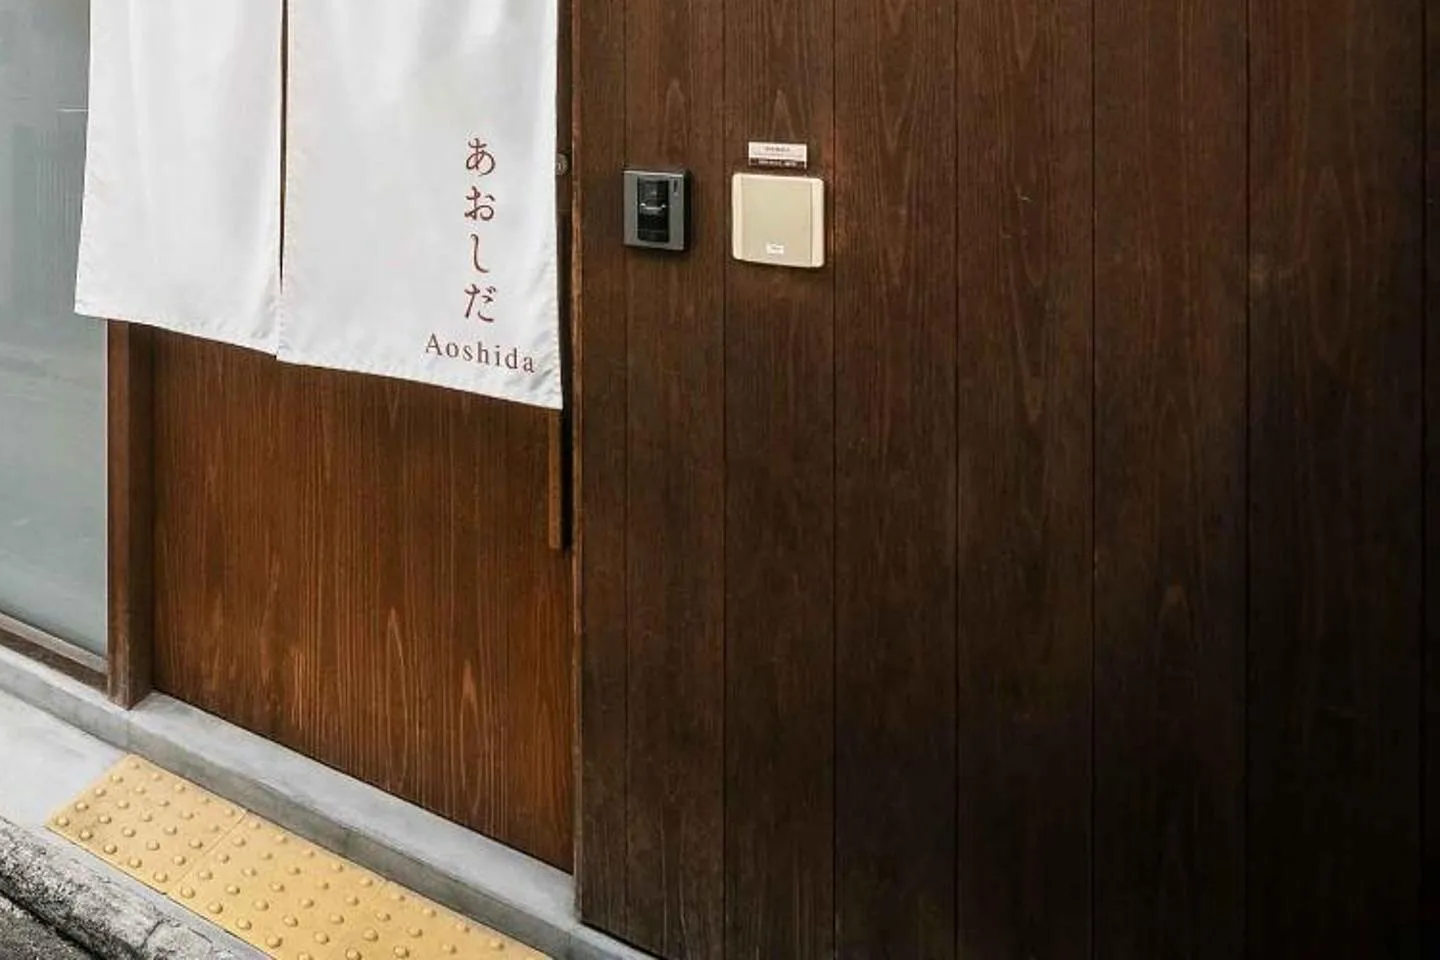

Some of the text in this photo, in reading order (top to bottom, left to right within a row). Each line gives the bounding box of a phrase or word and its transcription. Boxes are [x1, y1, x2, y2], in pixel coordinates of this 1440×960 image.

[464, 137, 497, 323] あおしだ
[425, 333, 535, 373] Aoshida
